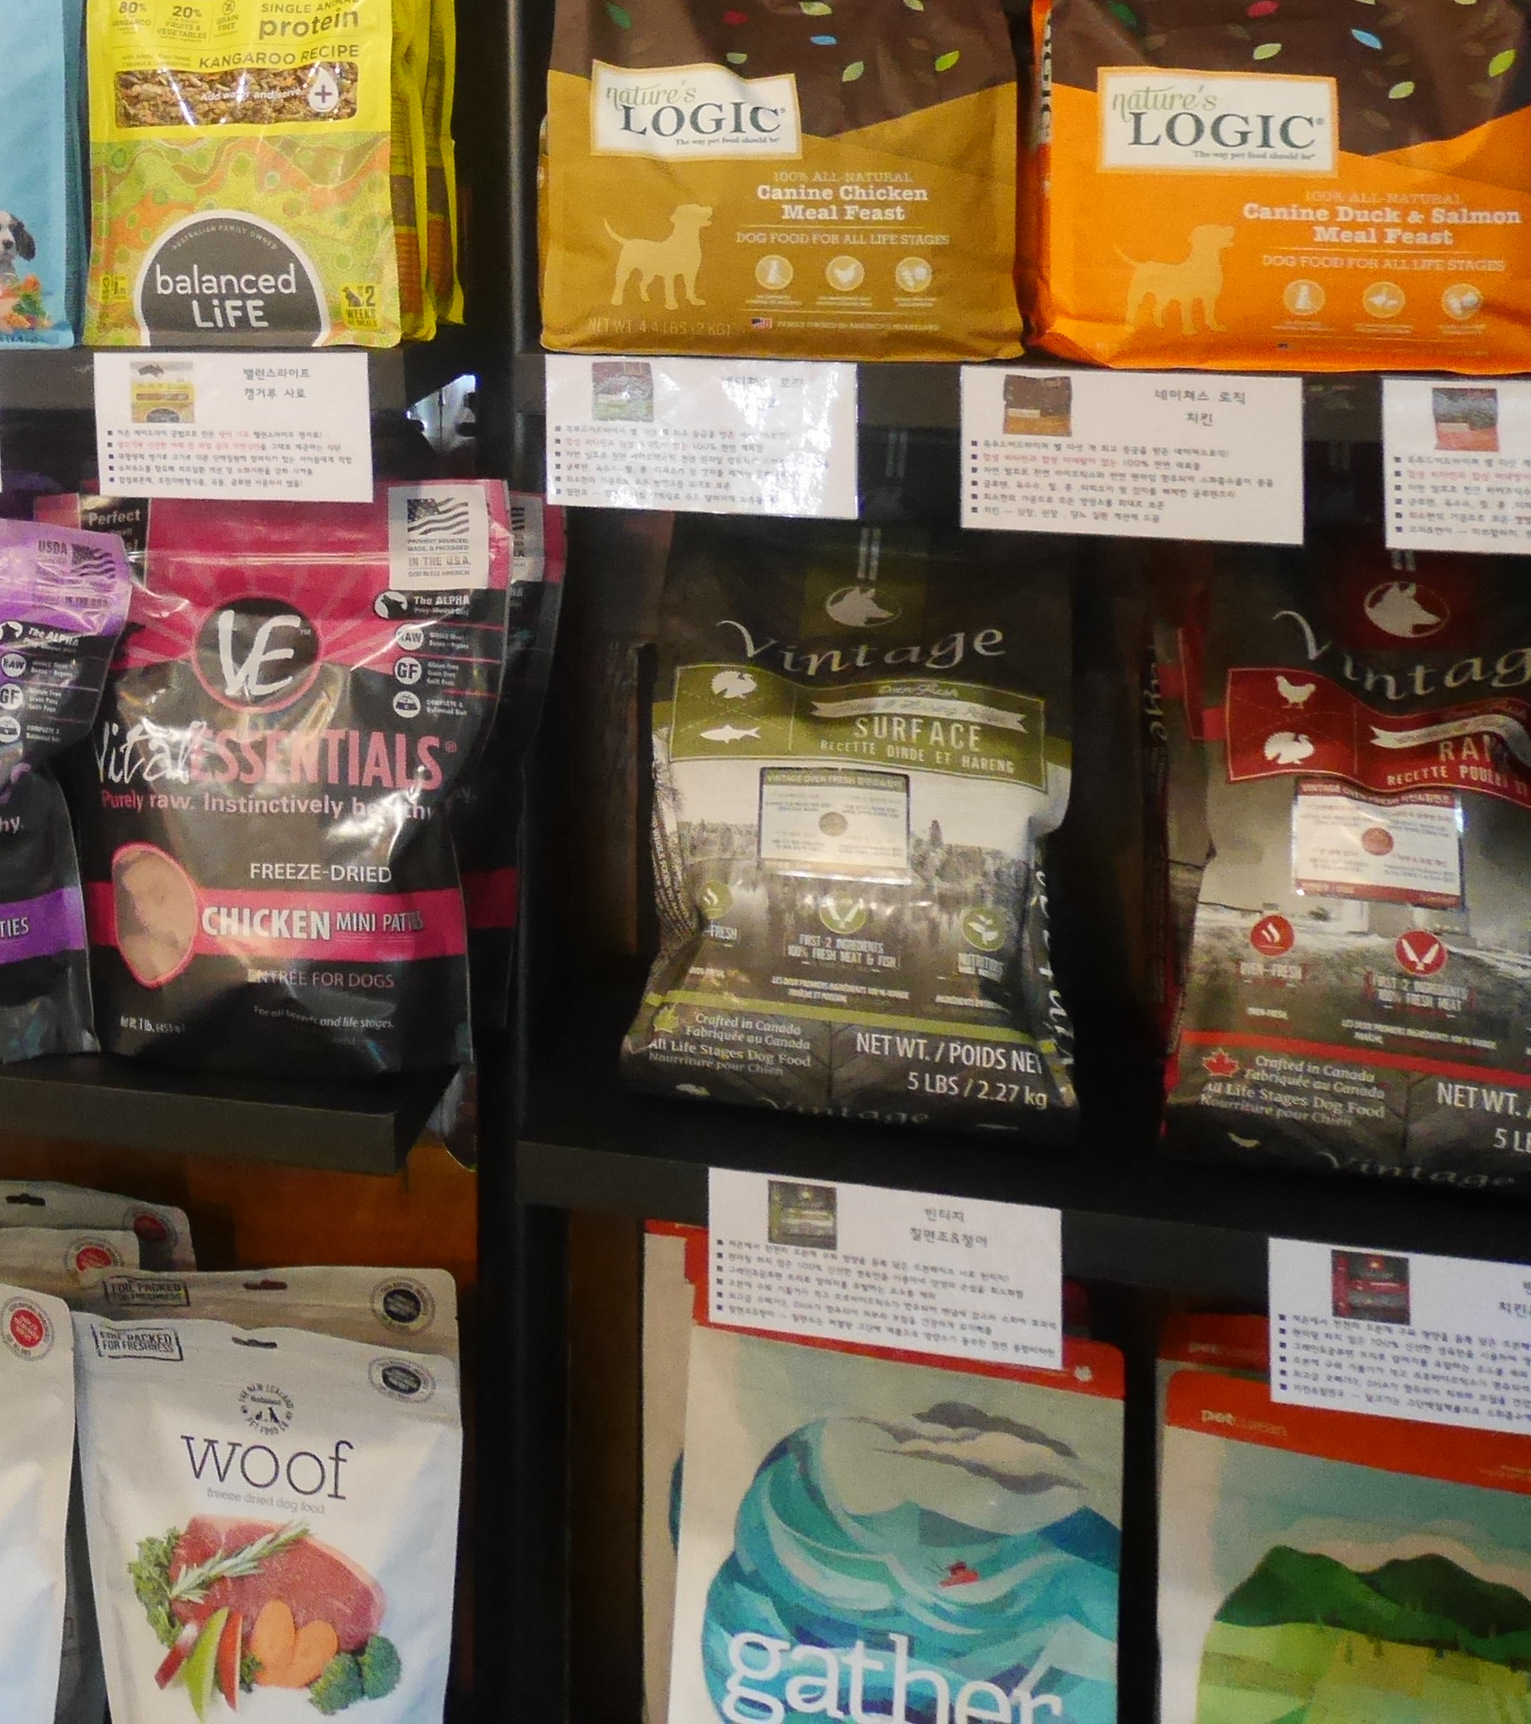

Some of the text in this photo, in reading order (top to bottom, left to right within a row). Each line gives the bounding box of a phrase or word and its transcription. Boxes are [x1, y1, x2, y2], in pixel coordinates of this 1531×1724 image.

[259, 7, 359, 40] protein
[261, 3, 311, 14] SINGLE
[200, 45, 360, 69] KANGAROO RECIPE
[621, 100, 782, 138] LOGIC
[1112, 84, 1217, 123] nature's
[1128, 112, 1315, 150] LOGIC
[757, 185, 929, 202] Canine Chicken
[782, 205, 906, 221] Meal Feast
[1244, 203, 1329, 222] Canine
[1336, 205, 1401, 224] Duck
[1431, 208, 1521, 225] Salmon
[1314, 227, 1453, 245] Meal Feast
[155, 263, 297, 295] balanced
[717, 620, 1006, 675] Vintage
[854, 716, 981, 752] SURFACE
[820, 740, 1015, 774] RECETTE DINDE ET HARENG
[203, 792, 343, 819] Instinctively
[250, 862, 392, 884] FREEZE-DRIED
[202, 906, 376, 940] CHICKEN MINI
[857, 1033, 1005, 1070] NET WT. POIDS
[908, 1073, 1047, 1110] 5 LBS 2.27 kg
[181, 1434, 355, 1501] woof
[722, 1631, 1063, 1724] gather
